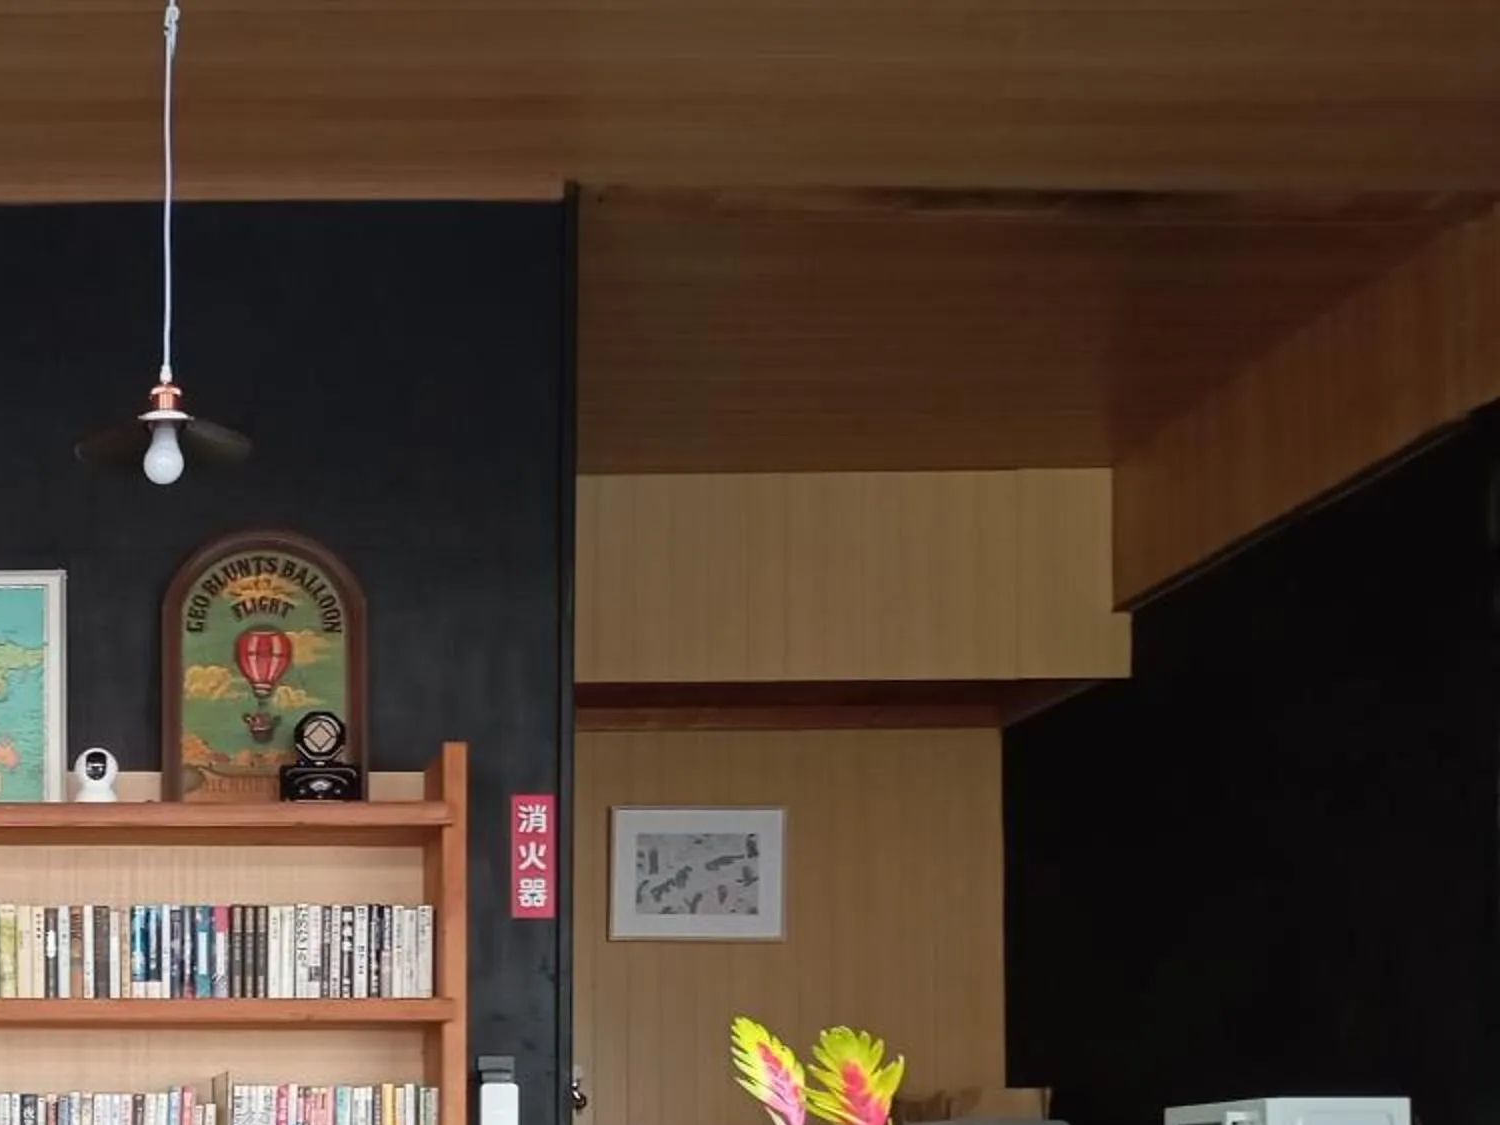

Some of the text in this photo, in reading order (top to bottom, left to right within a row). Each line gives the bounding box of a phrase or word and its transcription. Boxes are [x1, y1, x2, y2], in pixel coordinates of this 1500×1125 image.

[187, 556, 343, 634] GEO BLUNTS BALLOON
[231, 596, 296, 622] FLIGHT
[517, 804, 548, 908] 消火器
